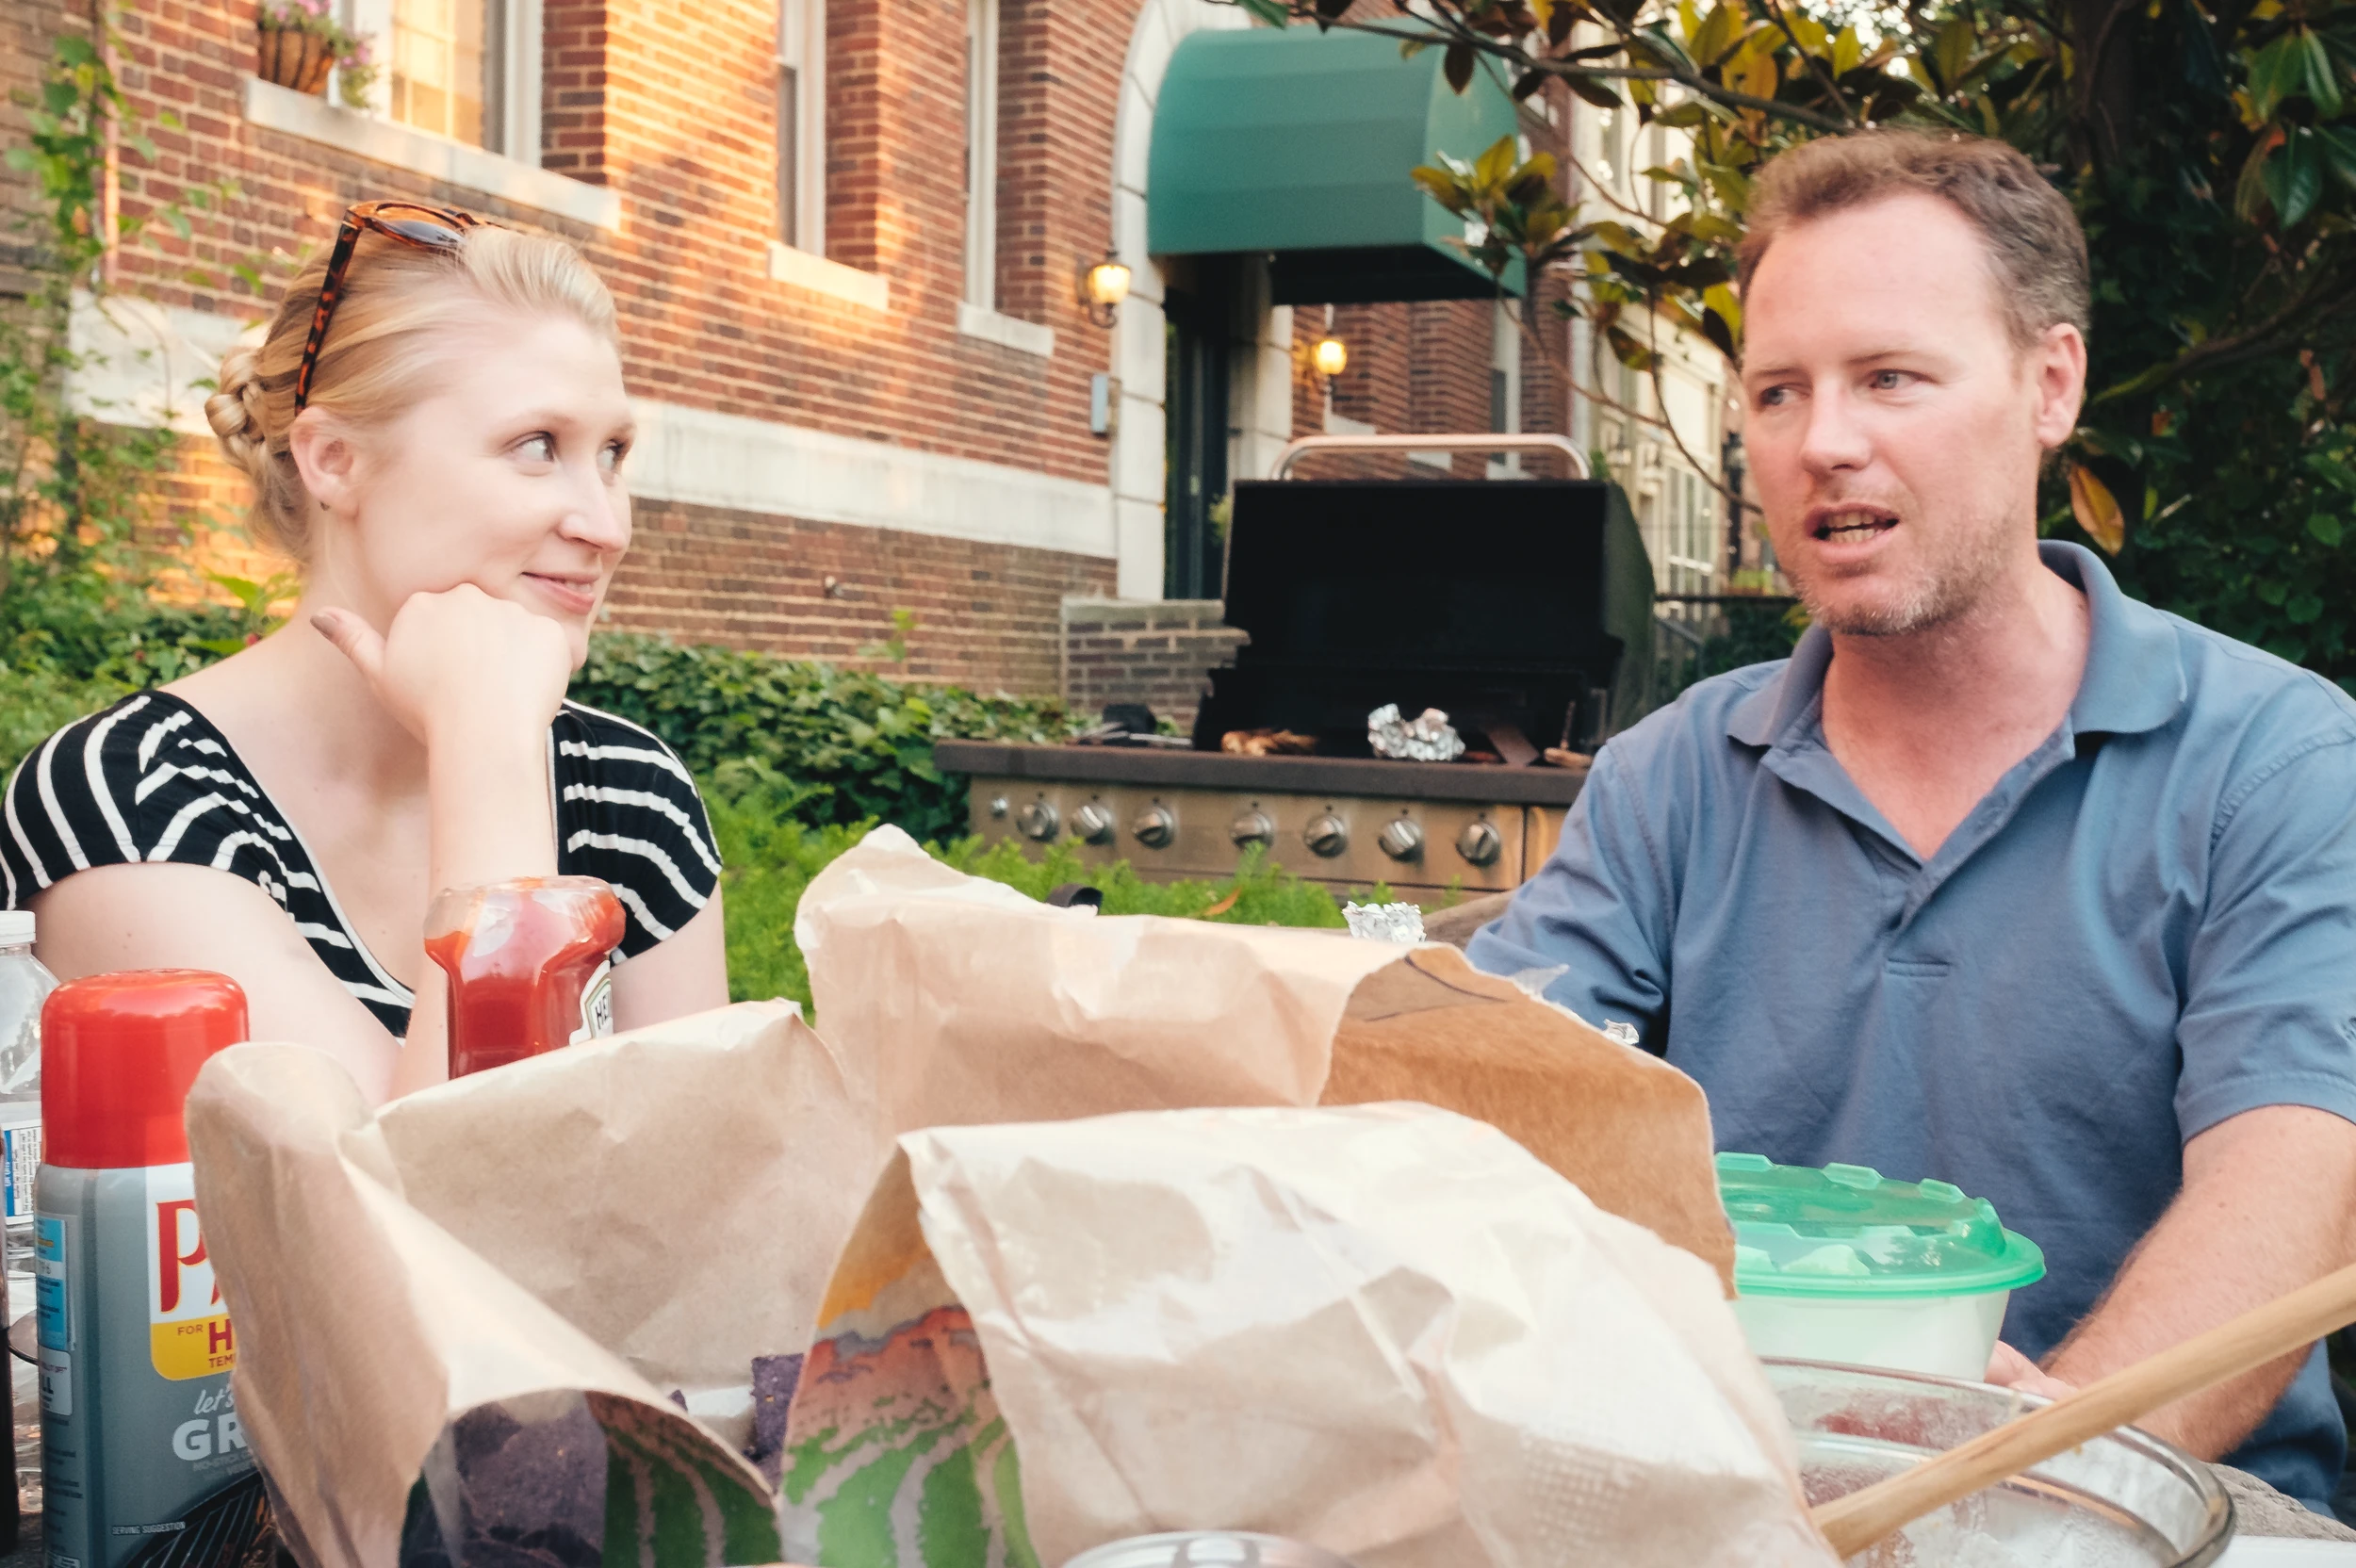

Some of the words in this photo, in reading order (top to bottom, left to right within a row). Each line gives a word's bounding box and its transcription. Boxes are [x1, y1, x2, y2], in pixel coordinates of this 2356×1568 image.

[155, 1199, 221, 1314] P
[177, 1324, 204, 1336] FOR
[207, 1354, 236, 1368] TEM
